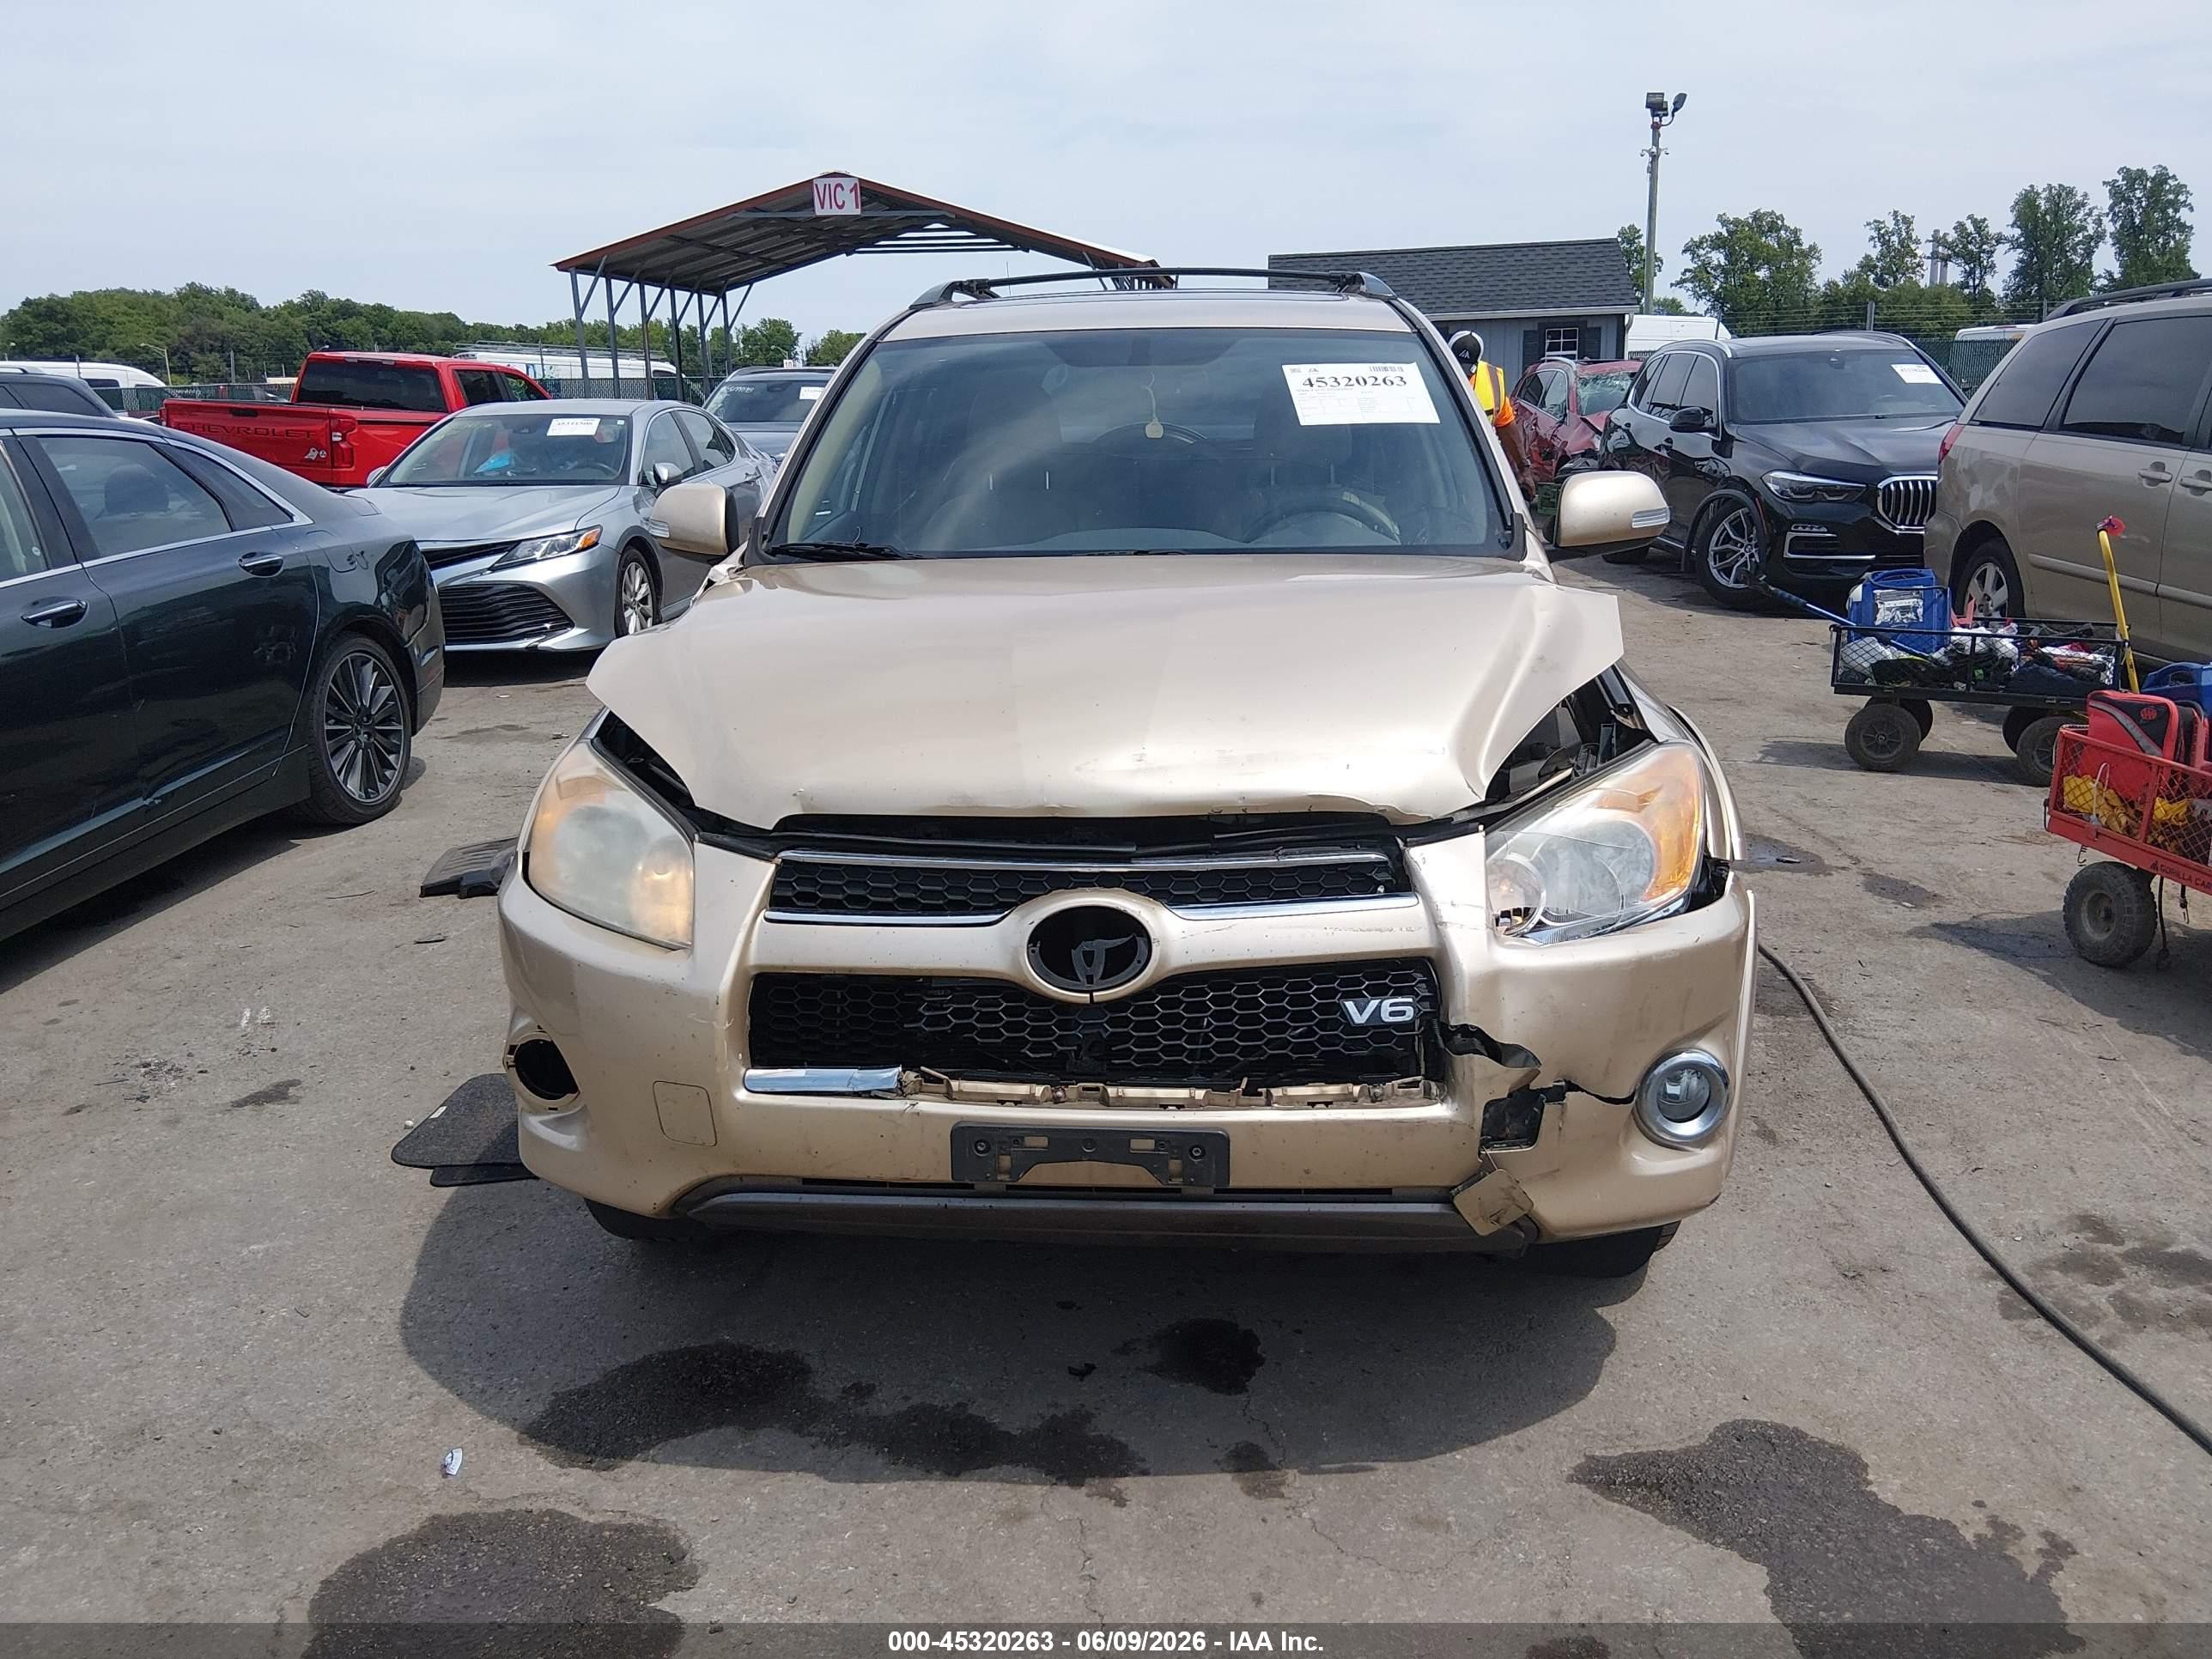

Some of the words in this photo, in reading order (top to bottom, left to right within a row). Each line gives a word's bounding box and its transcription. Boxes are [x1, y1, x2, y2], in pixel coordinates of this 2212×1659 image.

[815, 183, 845, 210] VIC
[849, 182, 860, 210] 1
[1303, 375, 1407, 388] 45320263
[177, 422, 316, 440] CHEVROLET
[1344, 998, 1414, 1024] V6
